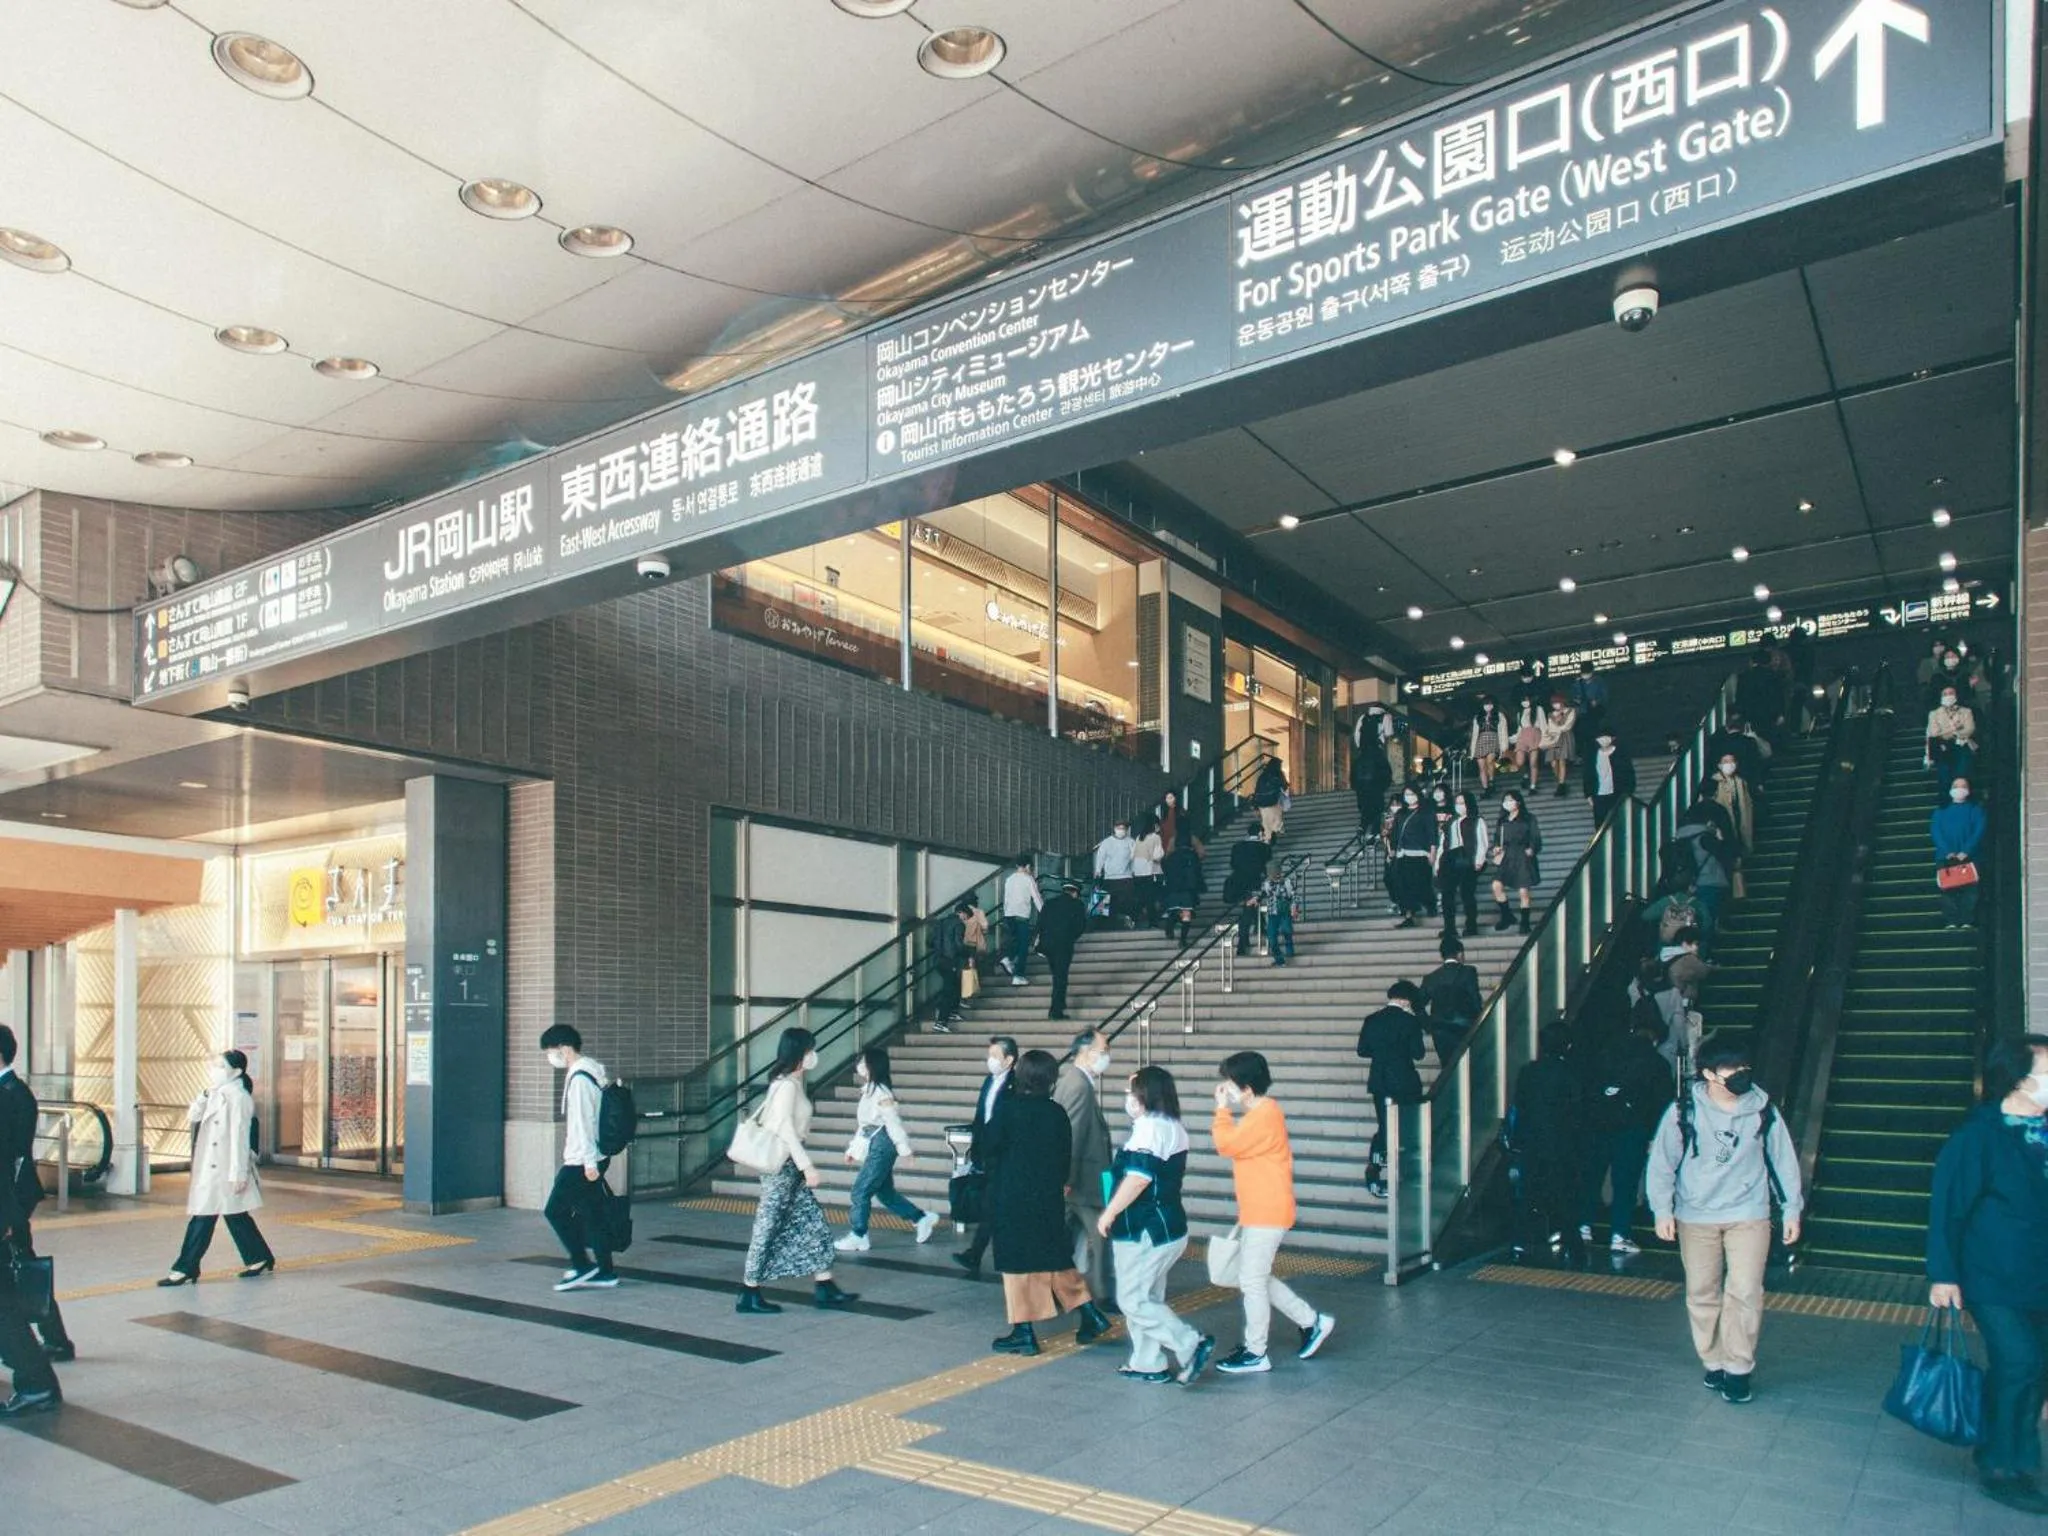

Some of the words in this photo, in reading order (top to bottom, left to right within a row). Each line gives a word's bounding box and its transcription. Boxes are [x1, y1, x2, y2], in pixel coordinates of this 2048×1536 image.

[1237, 9, 1790, 267] 運動公園口(西口)
[1238, 275, 1282, 313] For
[1288, 241, 1381, 299] Sports
[1389, 207, 1461, 262] Park
[1469, 181, 1551, 233] Gate
[1560, 138, 1668, 207] (West
[1678, 86, 1792, 163] Gate)
[876, 257, 1134, 366] 岡山コンベンションセンター
[1238, 303, 1315, 347] 운동공원
[1320, 272, 1411, 321] 출구(서쪽
[1418, 253, 1471, 290] 출구)
[876, 354, 928, 382] Okayama
[930, 328, 996, 363] Convention
[999, 314, 1039, 339] Center
[876, 319, 1091, 411] 岡山シティミュージアム
[900, 339, 1195, 448] 岡山市ももたろう観光センター
[876, 401, 929, 427] Okayama
[931, 391, 953, 409] City
[955, 374, 1006, 401] Museum
[901, 441, 939, 464] Tourist
[941, 421, 1010, 456] Information
[1012, 406, 1054, 430] Center
[560, 381, 820, 523] 東西連絡通路
[384, 484, 534, 581] JR岡山駅
[559, 522, 608, 558] East-West
[607, 508, 662, 543] Accessway
[383, 584, 428, 613] Okayama
[429, 570, 465, 599] Station
